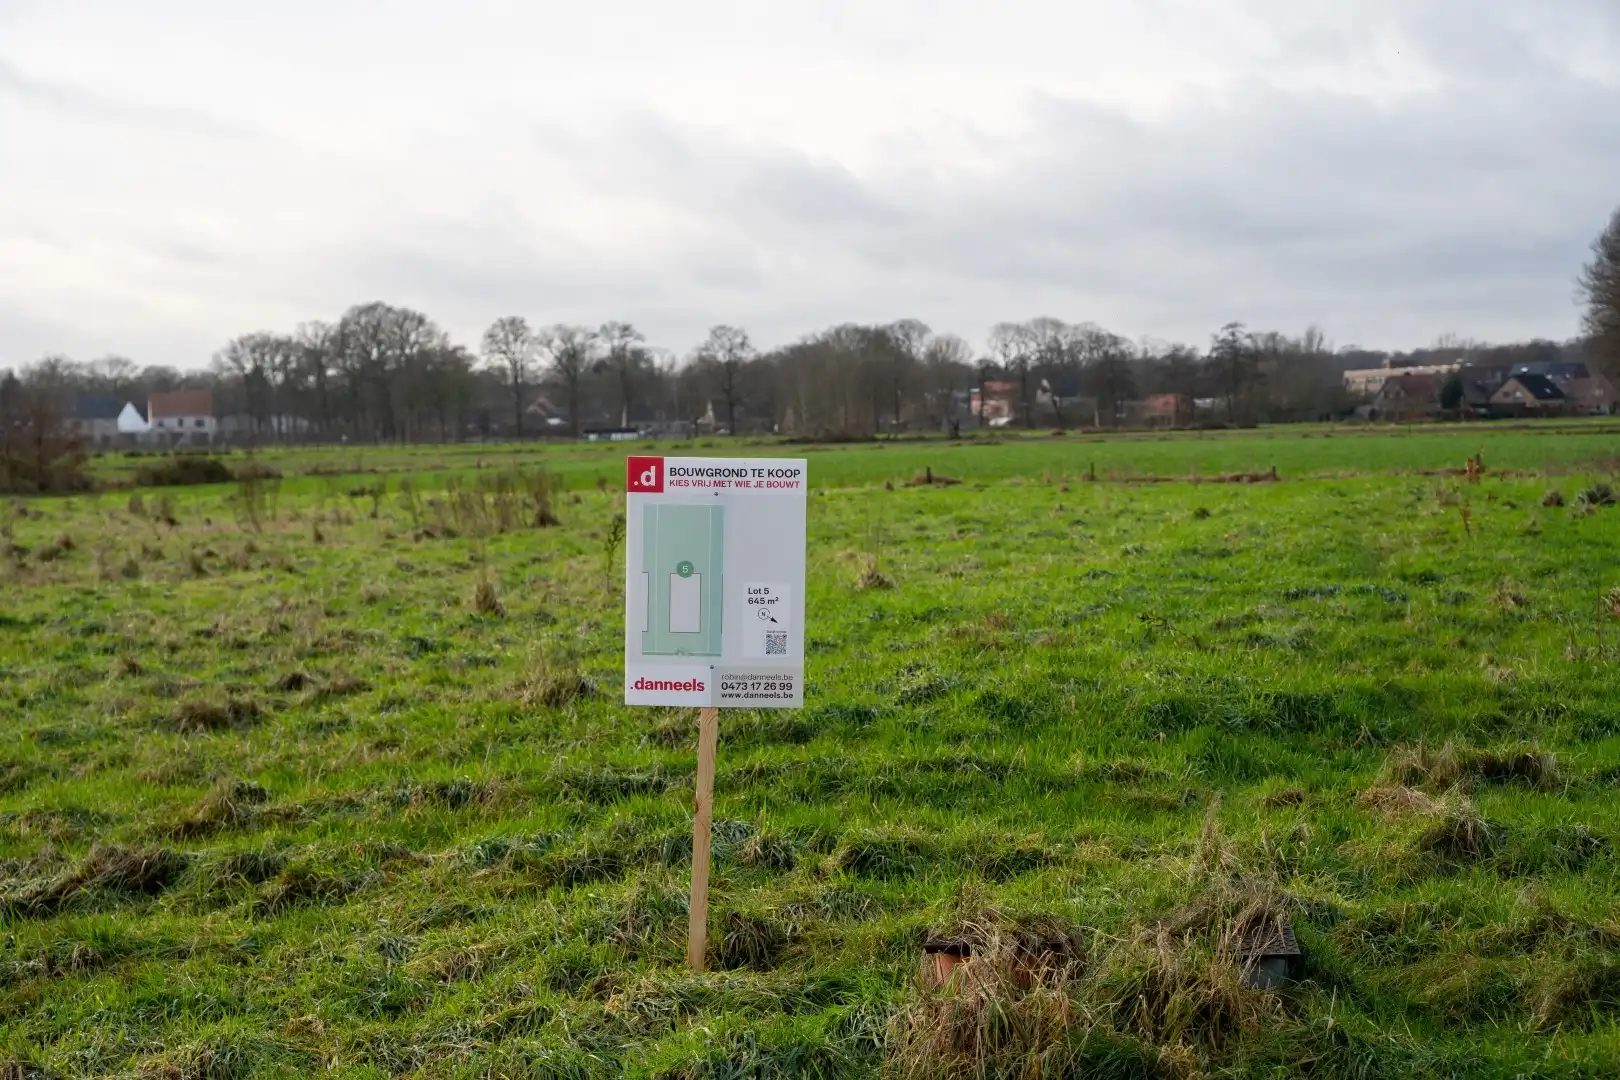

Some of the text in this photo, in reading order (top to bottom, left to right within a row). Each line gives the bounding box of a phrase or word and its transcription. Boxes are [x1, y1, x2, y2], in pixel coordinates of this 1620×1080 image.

[669, 467, 801, 479] BOUWGROND TE KOOP
[669, 479, 800, 489] KIES VRIJ MET WIE JE BOUWT
[682, 565, 689, 573] 5
[748, 587, 770, 595] Lot 5
[748, 597, 765, 605] 645
[630, 677, 705, 692] .danneels
[721, 682, 793, 691] 0473 17 26 99
